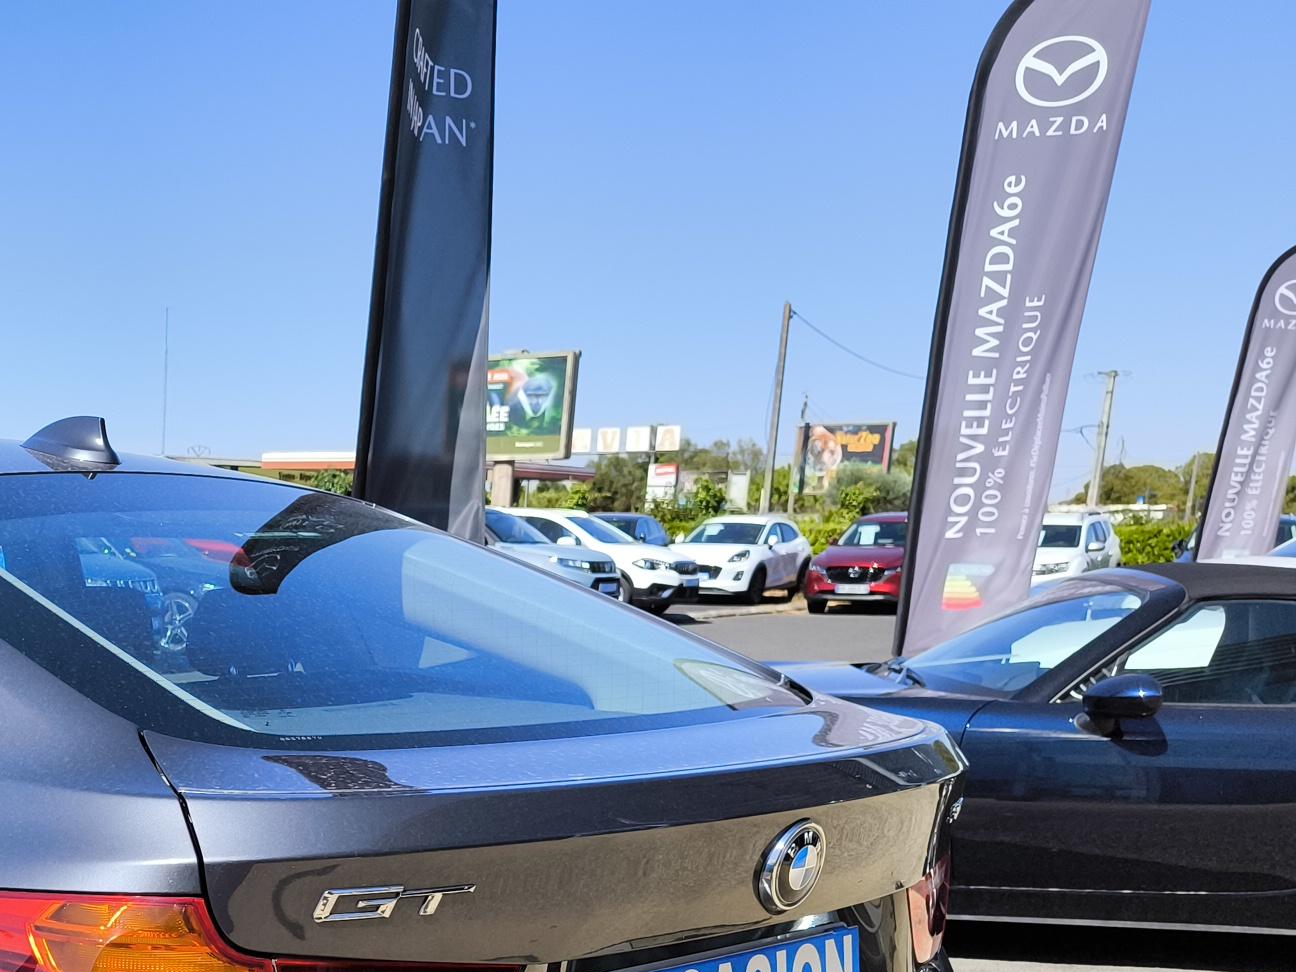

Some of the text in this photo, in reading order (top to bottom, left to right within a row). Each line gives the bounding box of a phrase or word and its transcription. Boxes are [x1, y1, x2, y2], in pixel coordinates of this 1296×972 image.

[994, 113, 1107, 140] MAZDA
[944, 367, 997, 539] NOUVELLE
[972, 174, 1026, 358] MAZDA6e
[976, 467, 1005, 537] 100%
[992, 294, 1046, 457] ÉLECTRIQUE
[1217, 445, 1254, 537] NOUVELLE
[1240, 346, 1277, 442] MAZDA6e
[312, 884, 477, 923] GT
